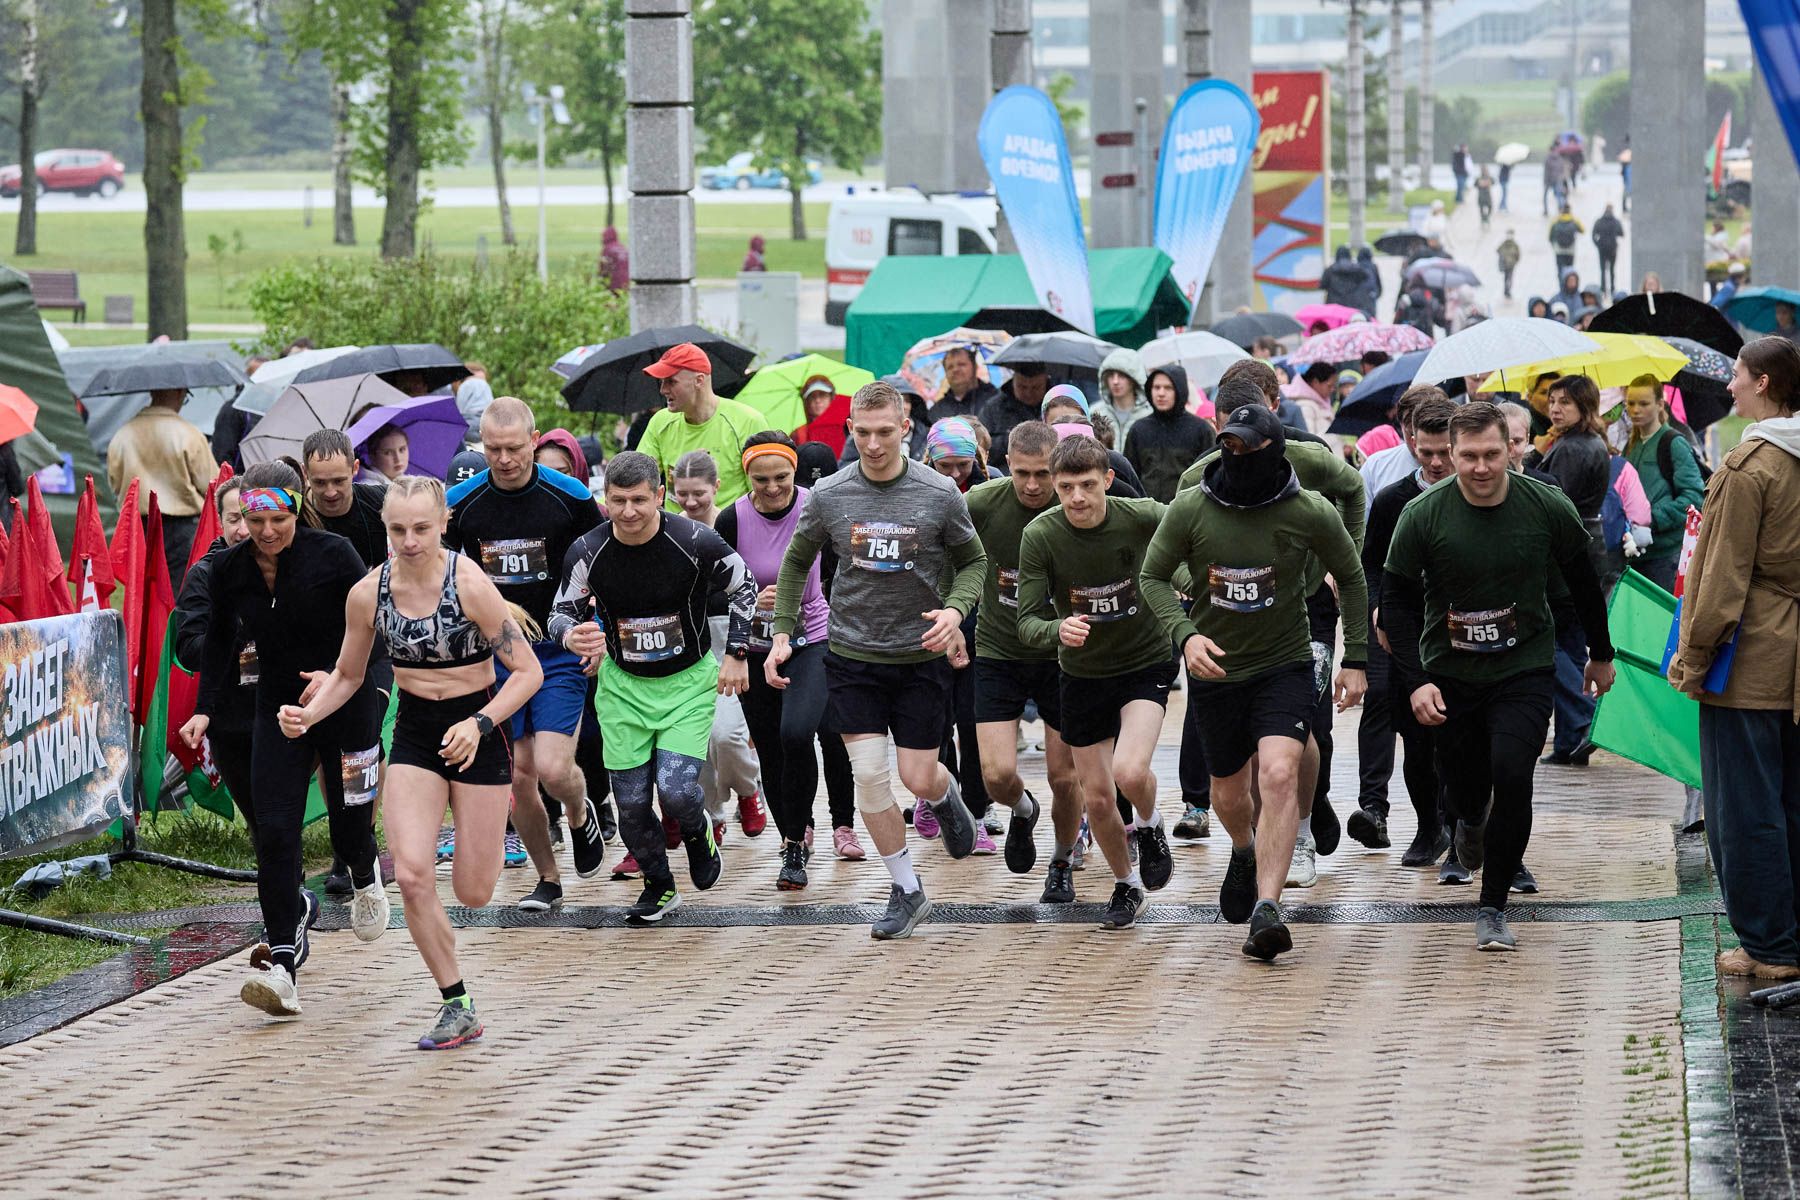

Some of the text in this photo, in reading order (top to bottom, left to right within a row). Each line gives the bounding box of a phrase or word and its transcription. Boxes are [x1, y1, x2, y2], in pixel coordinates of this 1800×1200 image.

[867, 539, 899, 559] 754
[499, 554, 529, 573] 791
[1224, 581, 1258, 601] 753
[1088, 596, 1119, 613] 751
[632, 631, 666, 650] 780
[1463, 624, 1499, 642] 755
[4, 637, 69, 737] ЗАБЕГ
[0, 701, 108, 820] ТВАЖНЫХ
